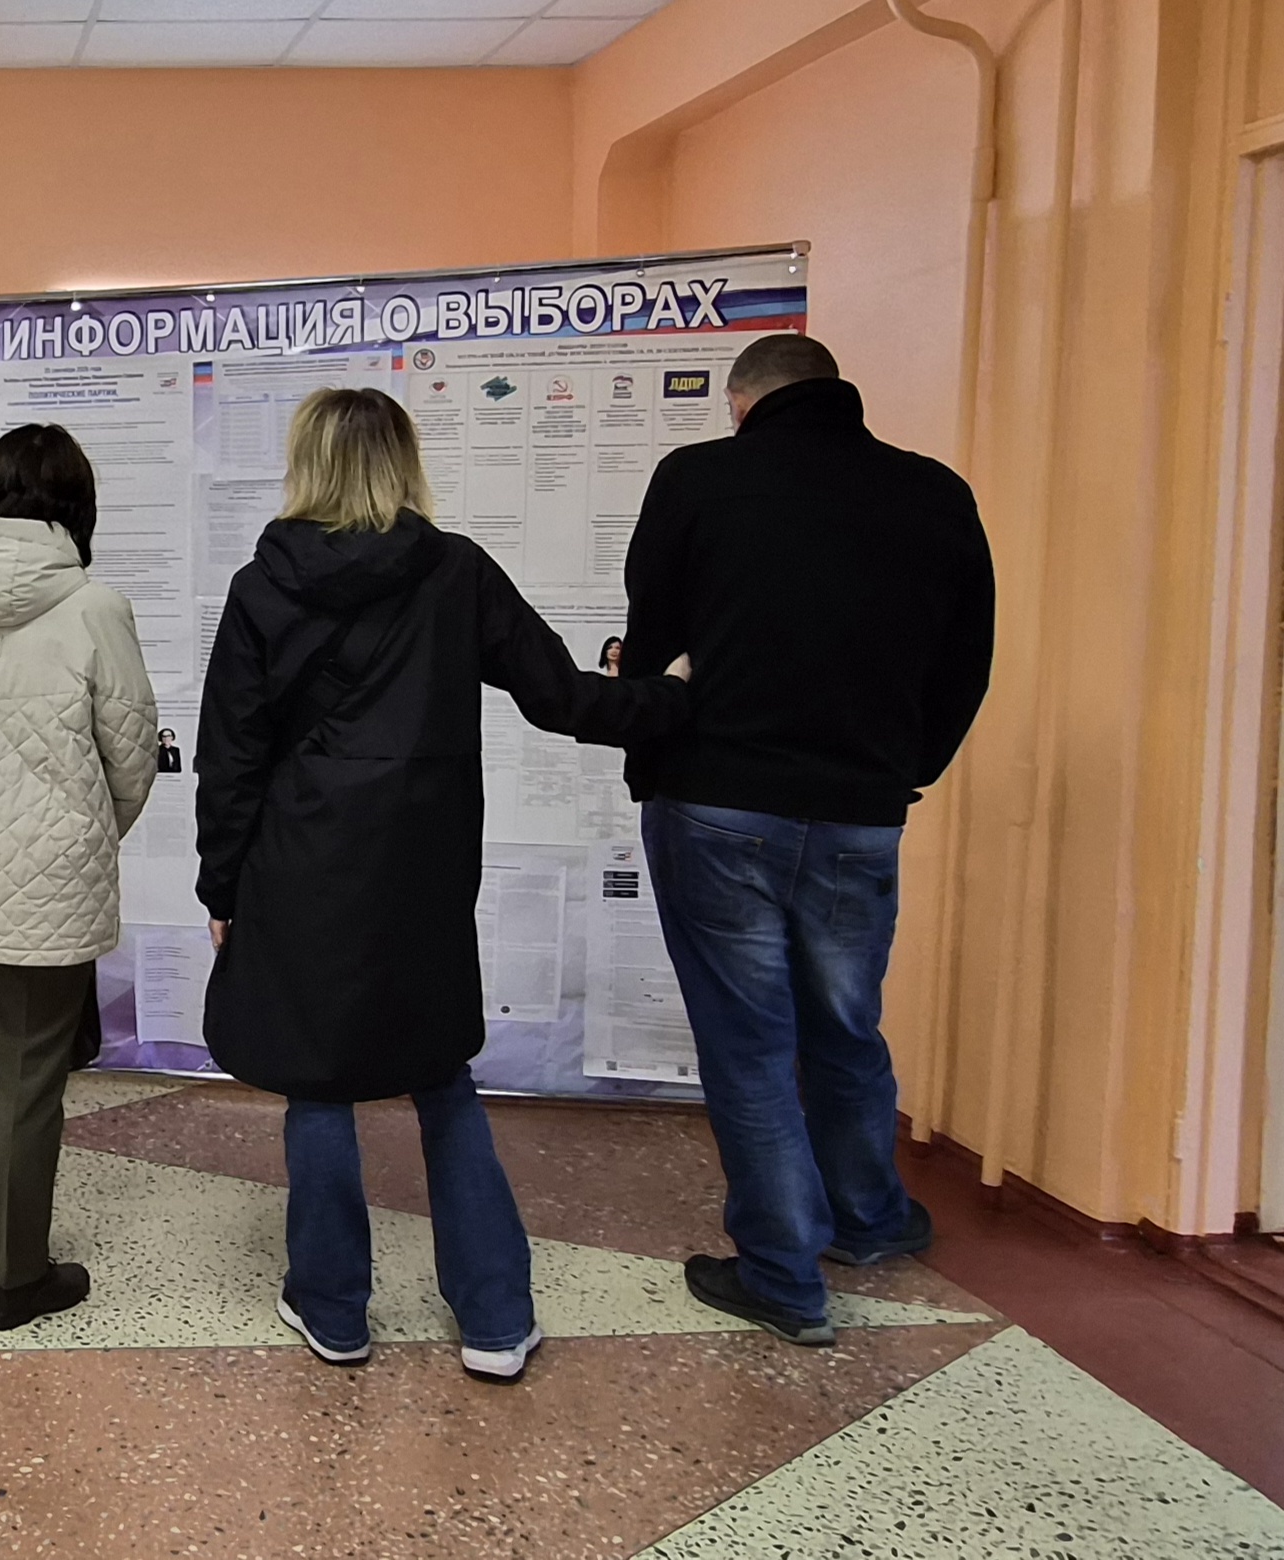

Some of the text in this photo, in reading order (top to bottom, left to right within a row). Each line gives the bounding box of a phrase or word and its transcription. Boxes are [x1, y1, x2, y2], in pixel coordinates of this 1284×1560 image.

[2, 278, 729, 361] ИНФОРМАЦИЯ О ВЫБОРАХ
[668, 377, 705, 392] ЛДПР
